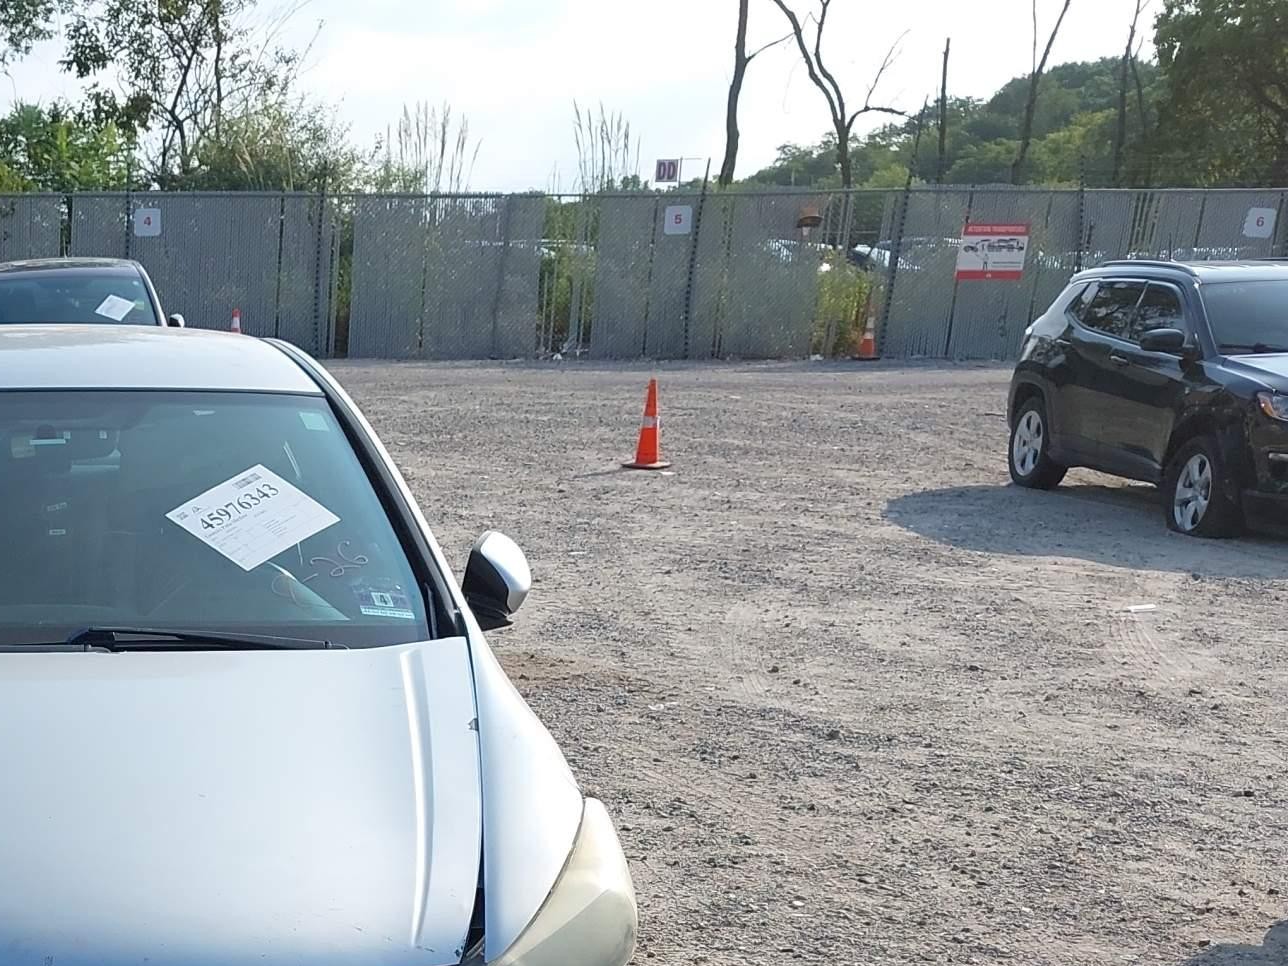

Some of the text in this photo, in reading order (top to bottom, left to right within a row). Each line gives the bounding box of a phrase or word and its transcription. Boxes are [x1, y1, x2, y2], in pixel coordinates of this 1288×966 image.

[658, 161, 677, 180] DD
[143, 216, 152, 227] 4
[674, 214, 683, 225] 5
[1255, 216, 1265, 228] 6
[200, 483, 279, 530] 45976343
